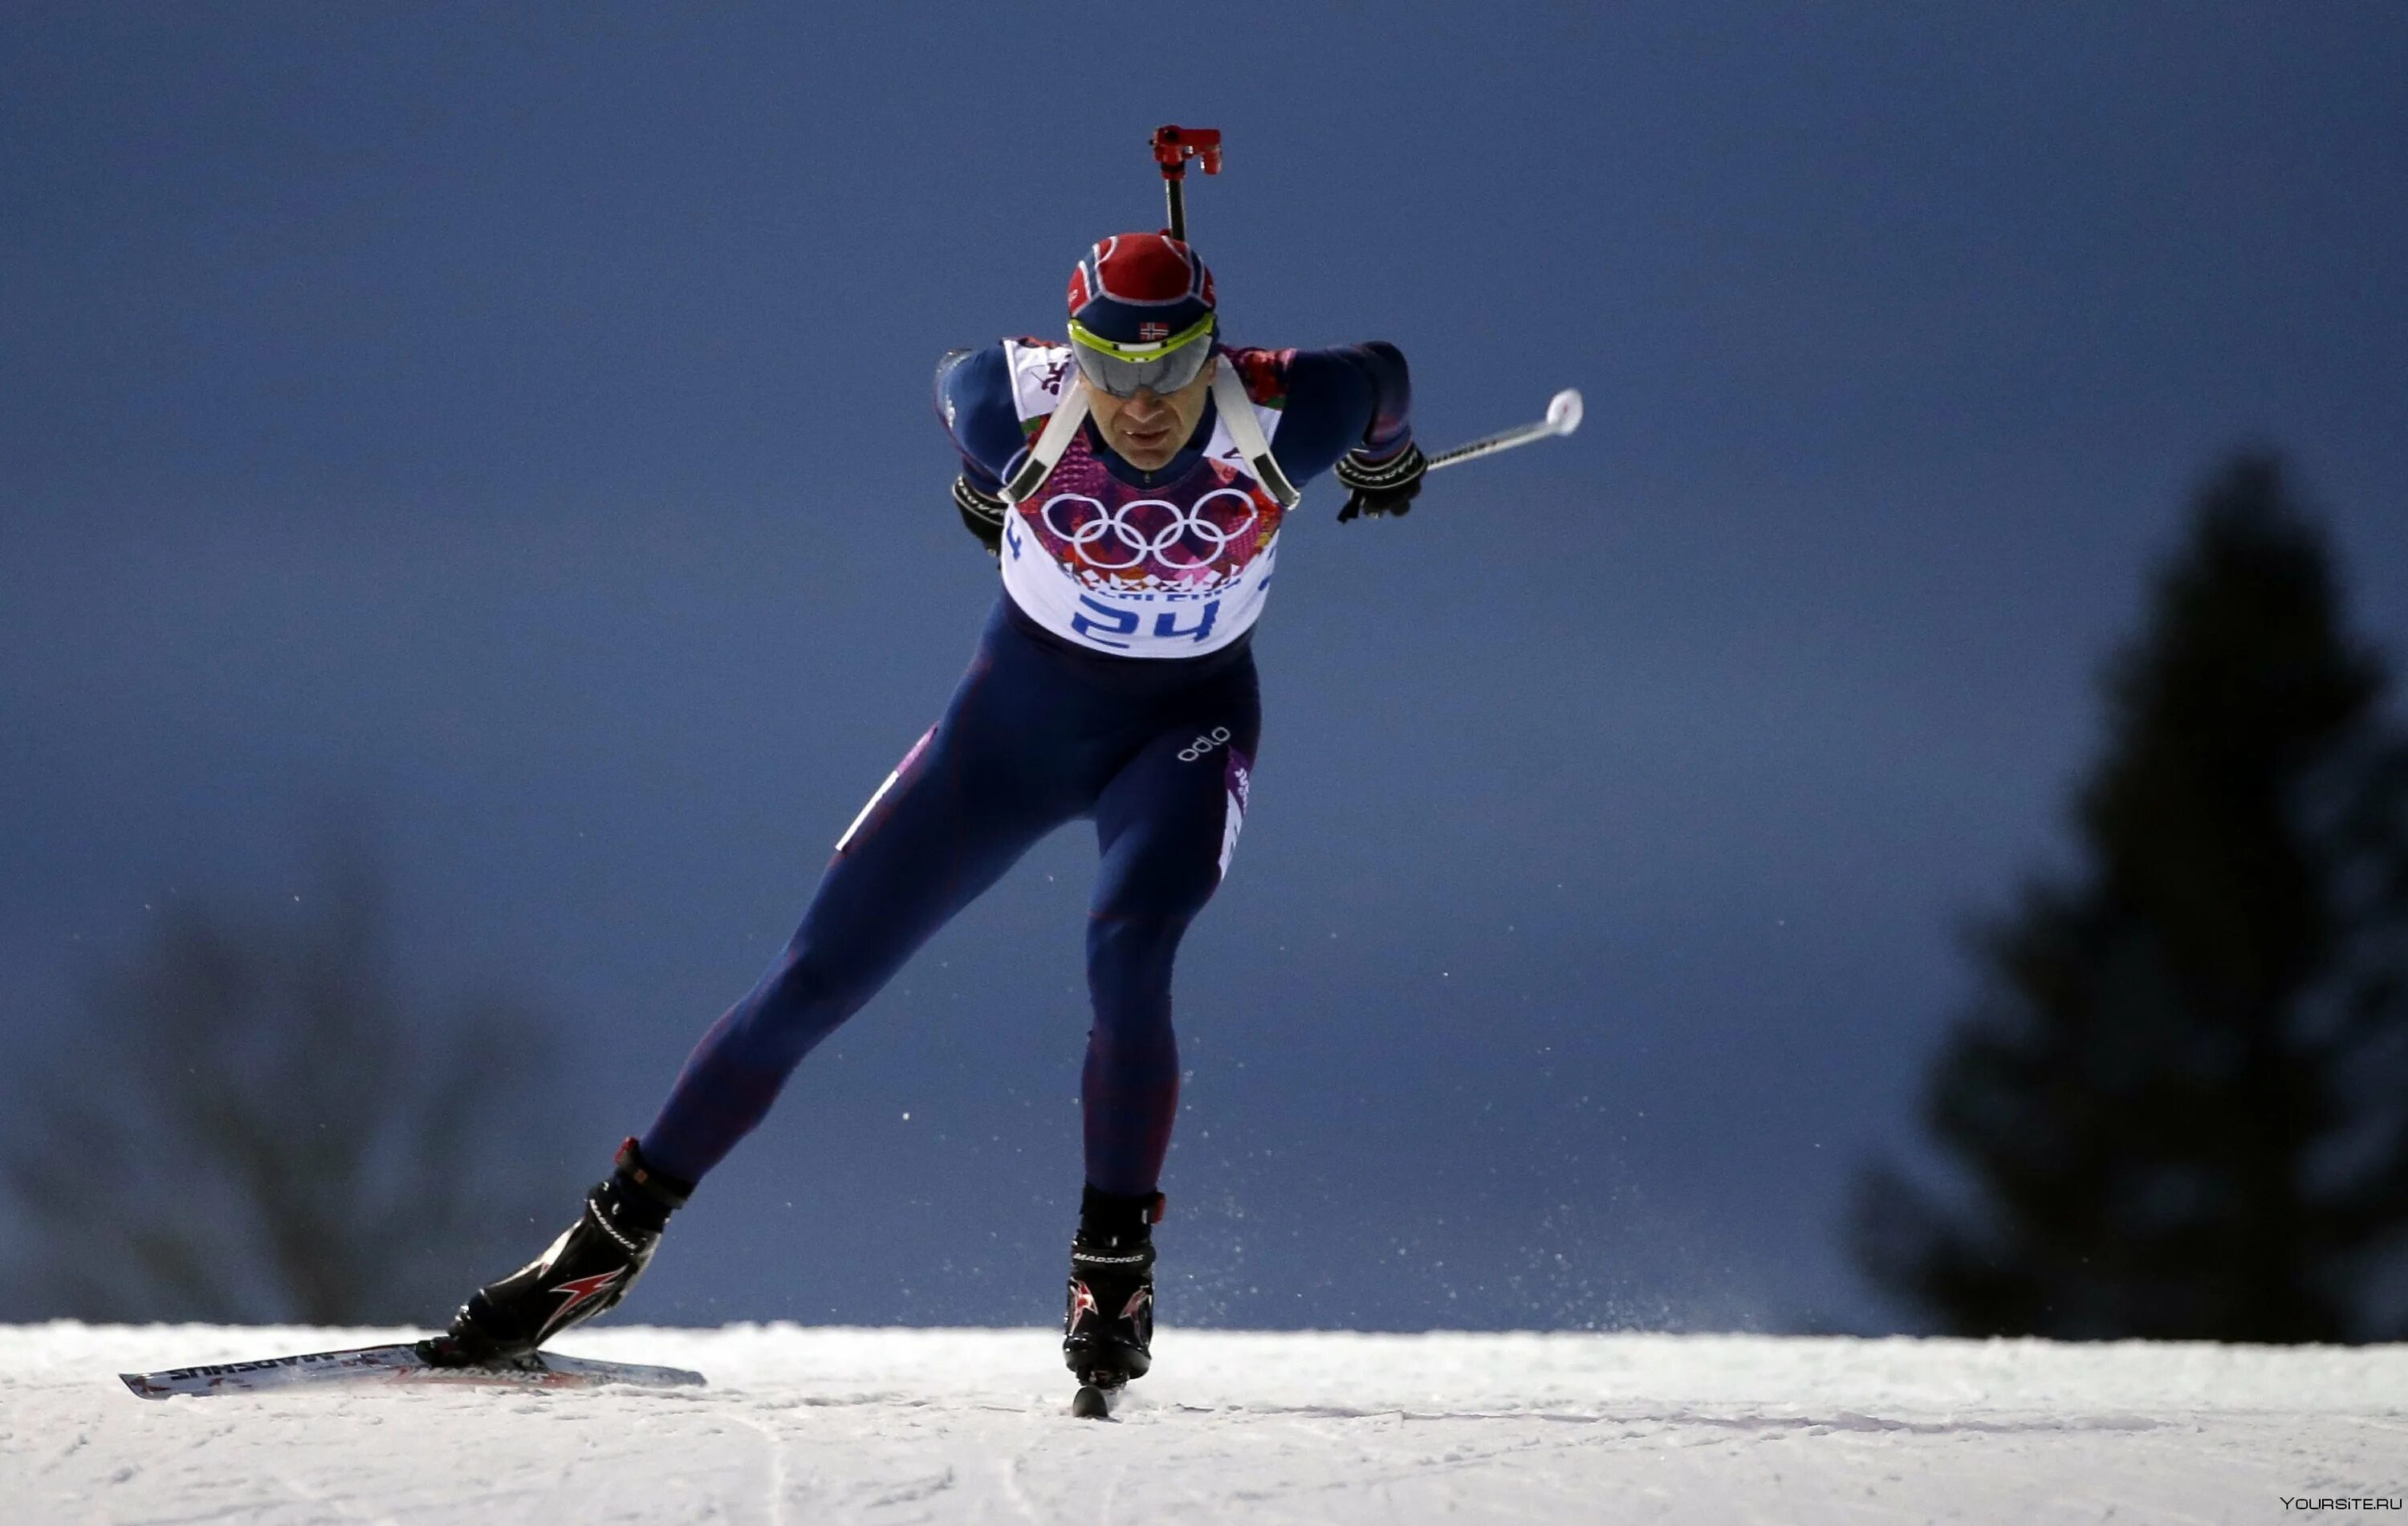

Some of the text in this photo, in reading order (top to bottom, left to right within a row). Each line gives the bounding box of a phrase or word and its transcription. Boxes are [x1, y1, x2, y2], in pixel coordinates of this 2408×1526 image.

[1072, 593, 1220, 649] 24
[1178, 726, 1230, 762] odlo
[589, 1198, 637, 1249] MADSHUS
[1073, 1252, 1144, 1264] MADSHUS
